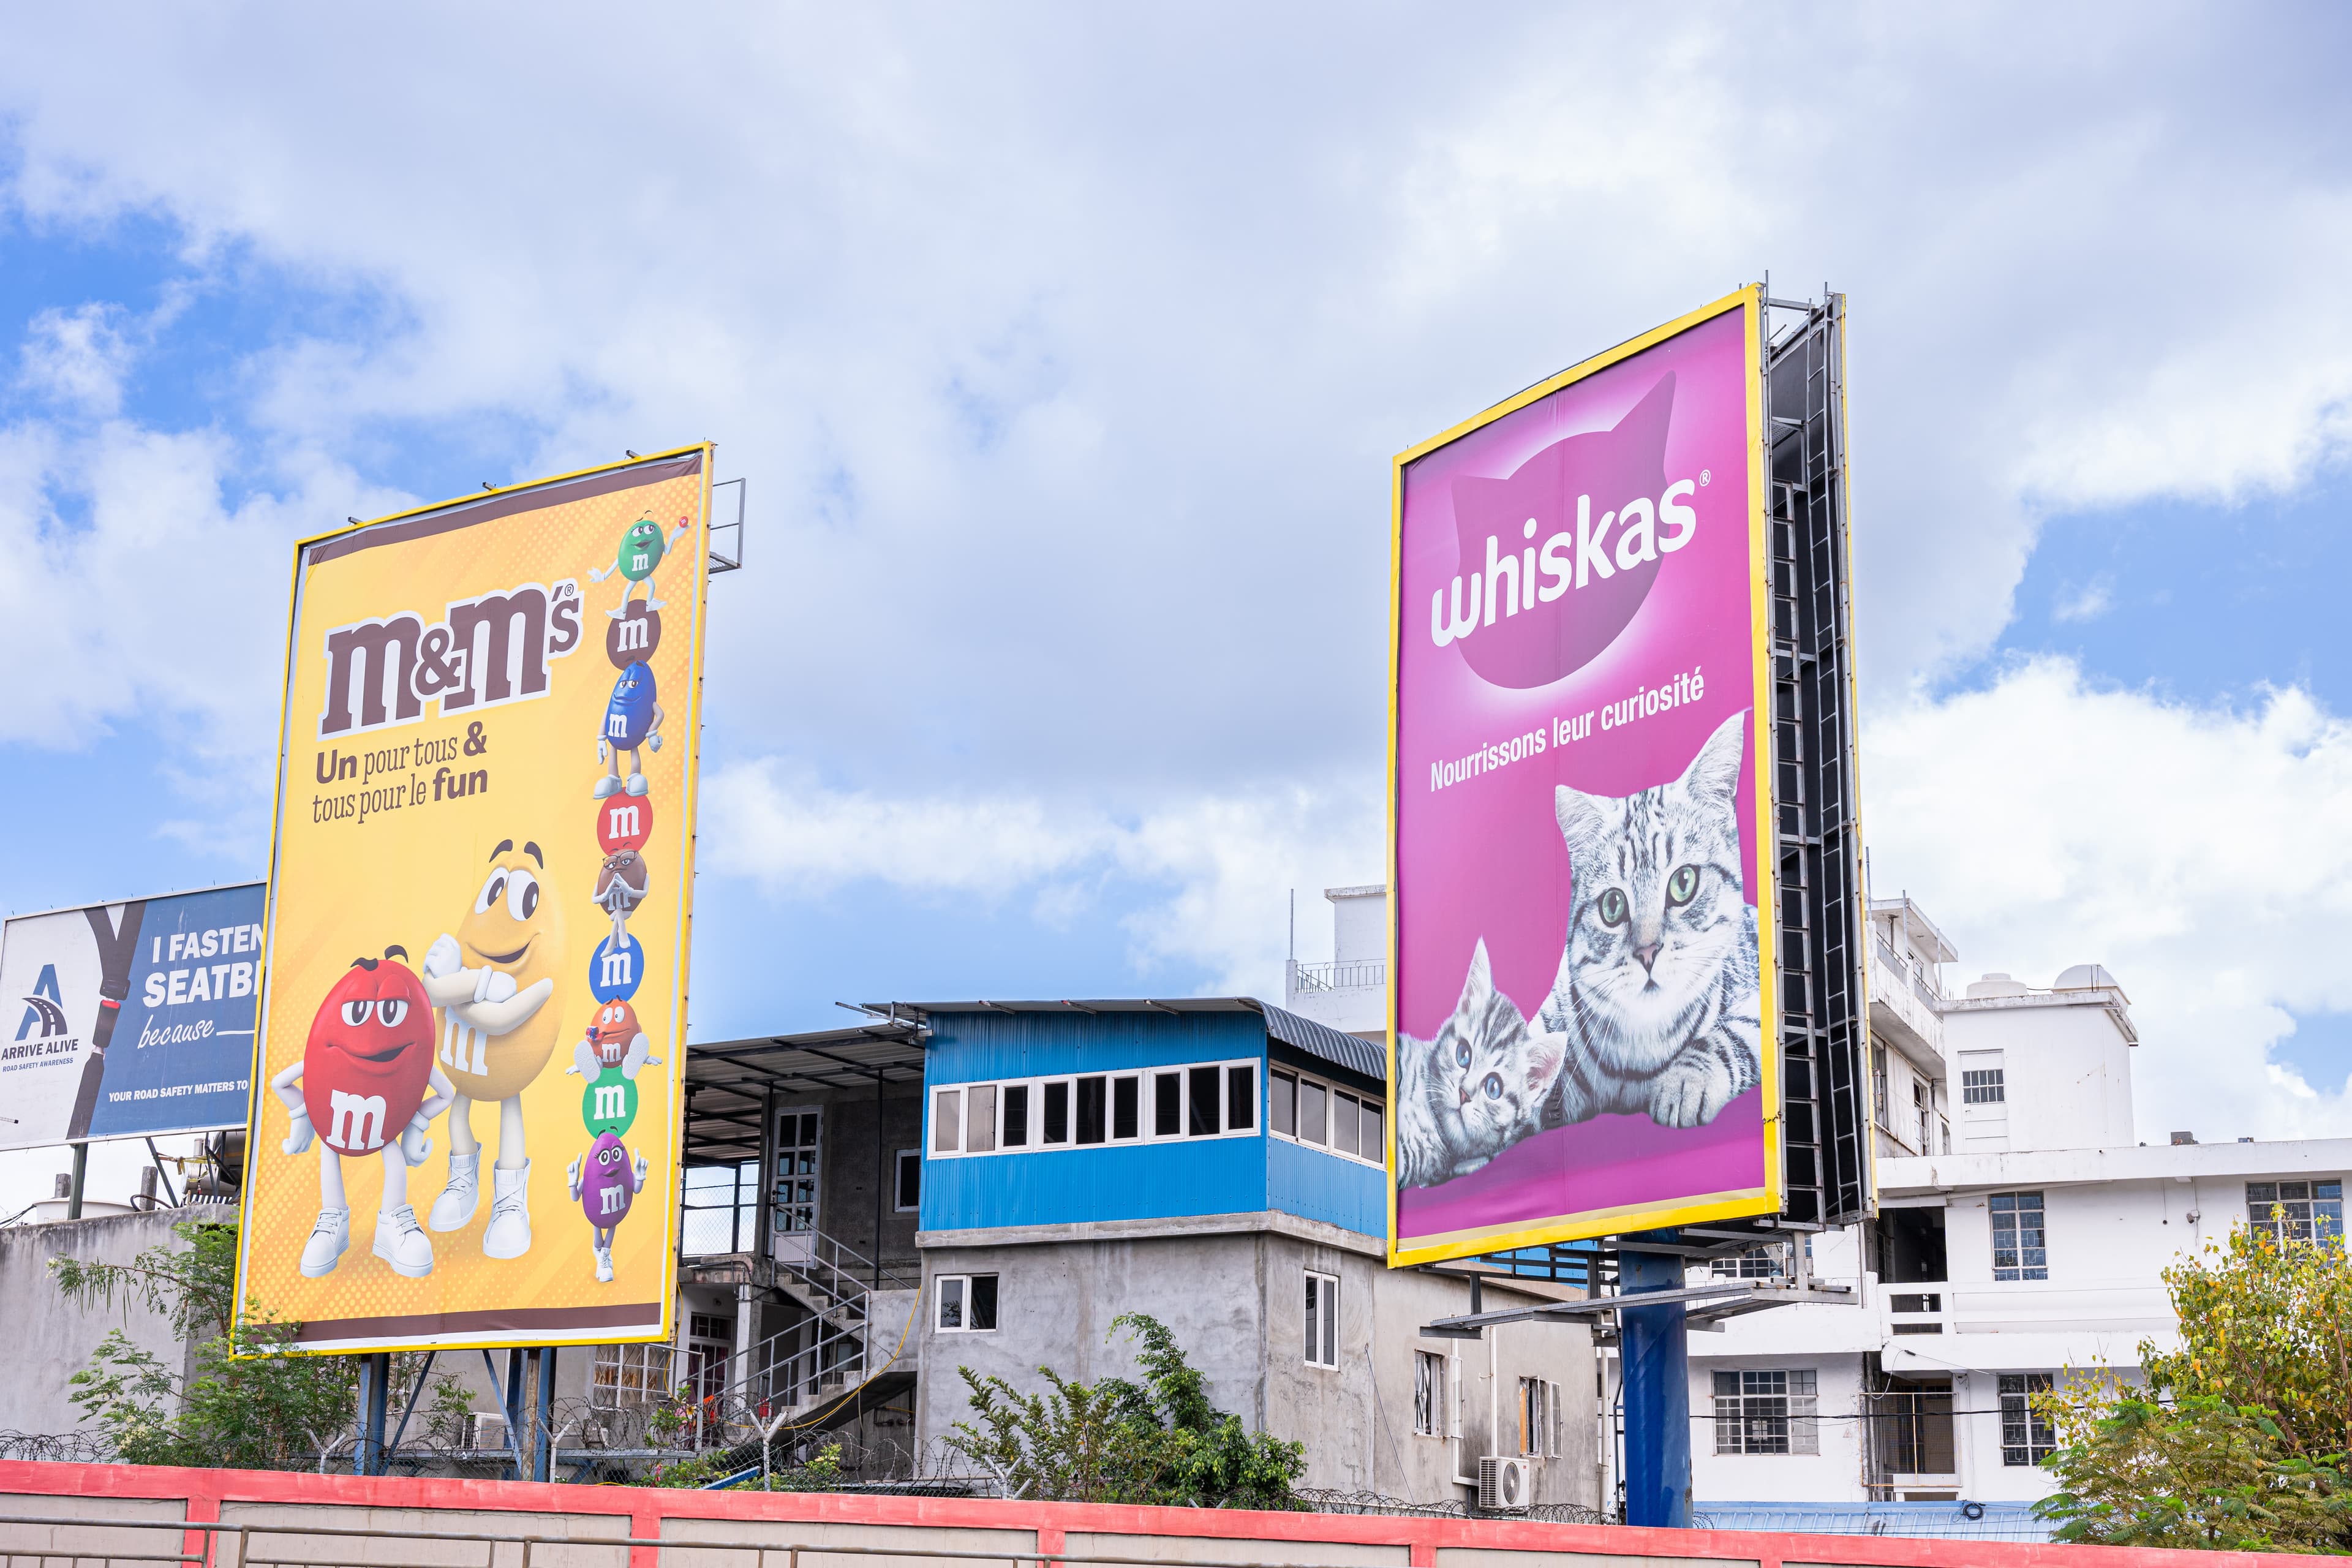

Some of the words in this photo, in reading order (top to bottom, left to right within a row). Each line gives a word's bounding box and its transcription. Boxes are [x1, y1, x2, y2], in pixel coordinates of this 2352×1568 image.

[1431, 728, 1546, 792] Nourrissons
[1553, 710, 1594, 748] leur
[1600, 666, 1705, 731] curiosité
[316, 749, 357, 784] Un
[362, 745, 410, 785] pour
[413, 736, 458, 766] tous
[463, 721, 488, 757] &
[312, 793, 355, 823] tous
[358, 785, 406, 824] pour
[409, 773, 426, 806] le
[432, 767, 488, 801] fun
[152, 936, 162, 963] I
[168, 923, 263, 962] FASTEN
[1, 1043, 43, 1060] ARRIVE
[45, 1039, 78, 1055] ALIVE
[137, 1014, 214, 1049] because
[19, 1061, 39, 1070] SAFETY
[40, 1057, 74, 1067] AWARENESS
[108, 1091, 132, 1102] YOUR
[134, 1088, 159, 1100] ROAD
[160, 1085, 192, 1097] SAFETY
[194, 1081, 235, 1093] MATTERS
[236, 1080, 248, 1090] TO
